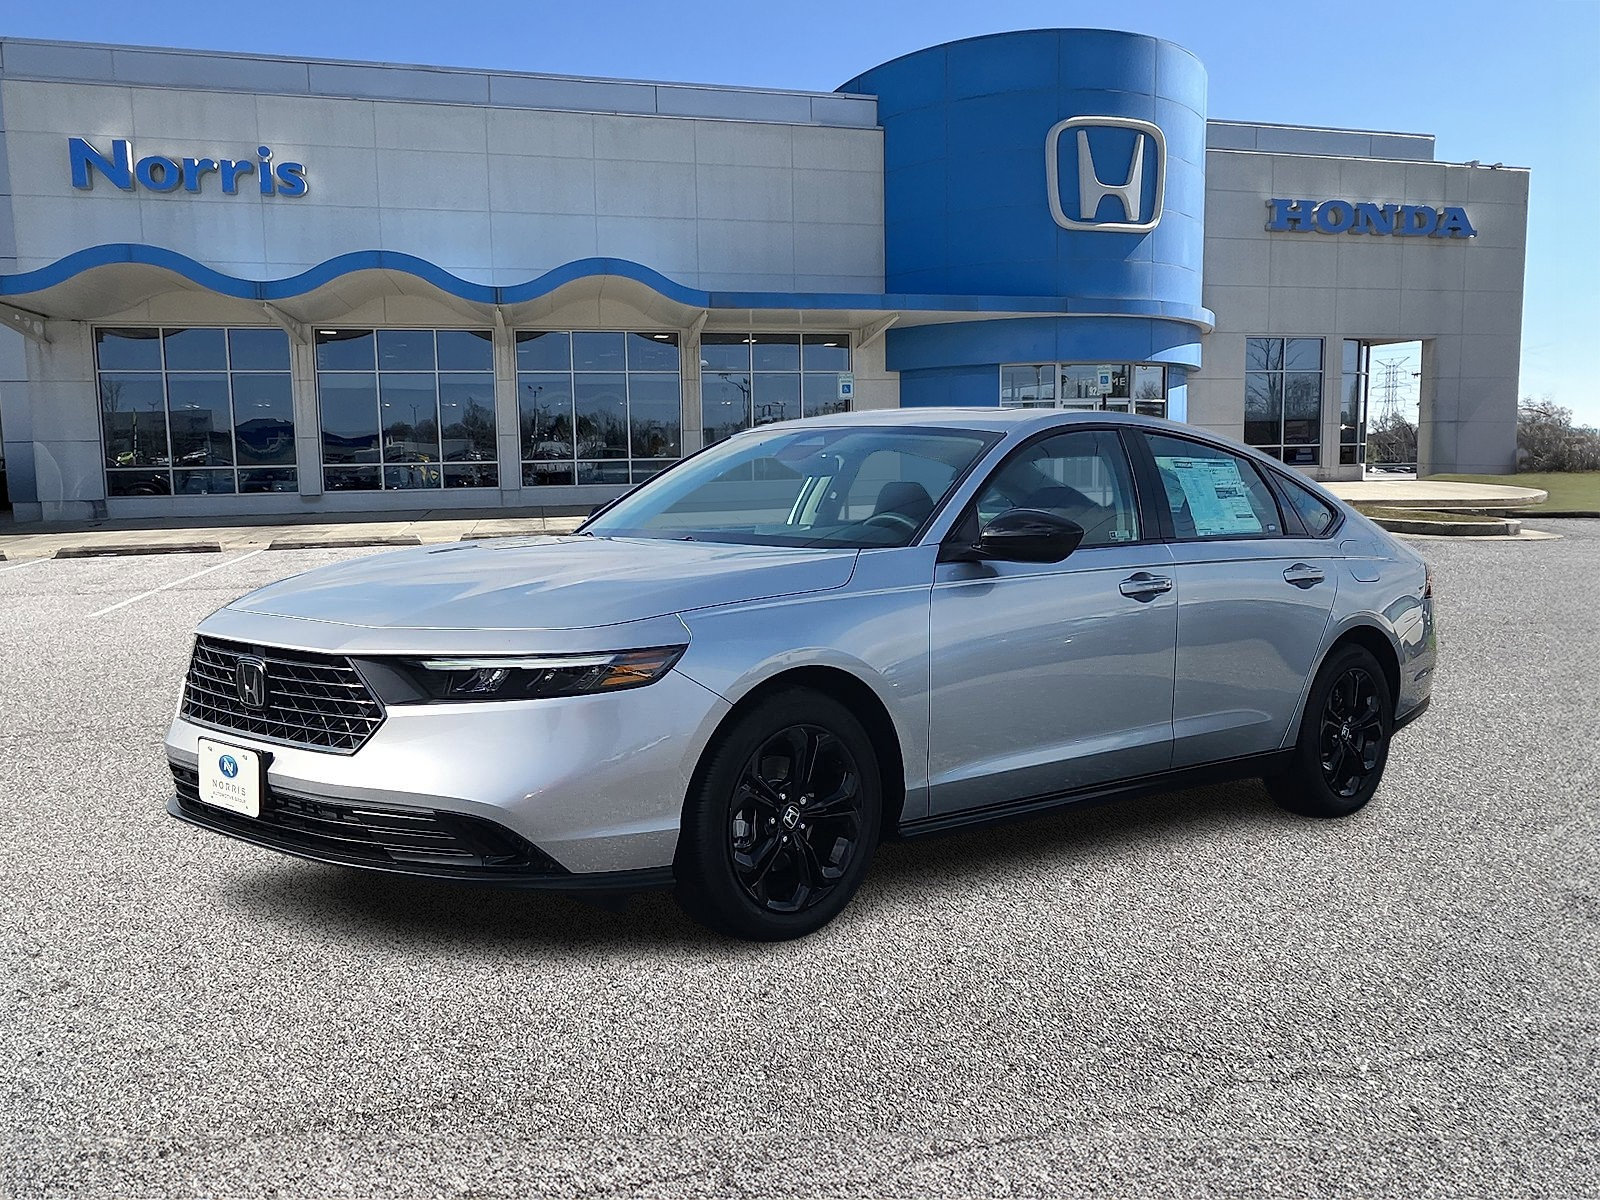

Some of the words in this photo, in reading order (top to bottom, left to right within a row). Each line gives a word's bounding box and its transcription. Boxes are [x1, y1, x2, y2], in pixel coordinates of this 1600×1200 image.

[68, 137, 308, 197] Norris
[1265, 198, 1478, 239] HONDA
[212, 779, 246, 796] NORRIS
